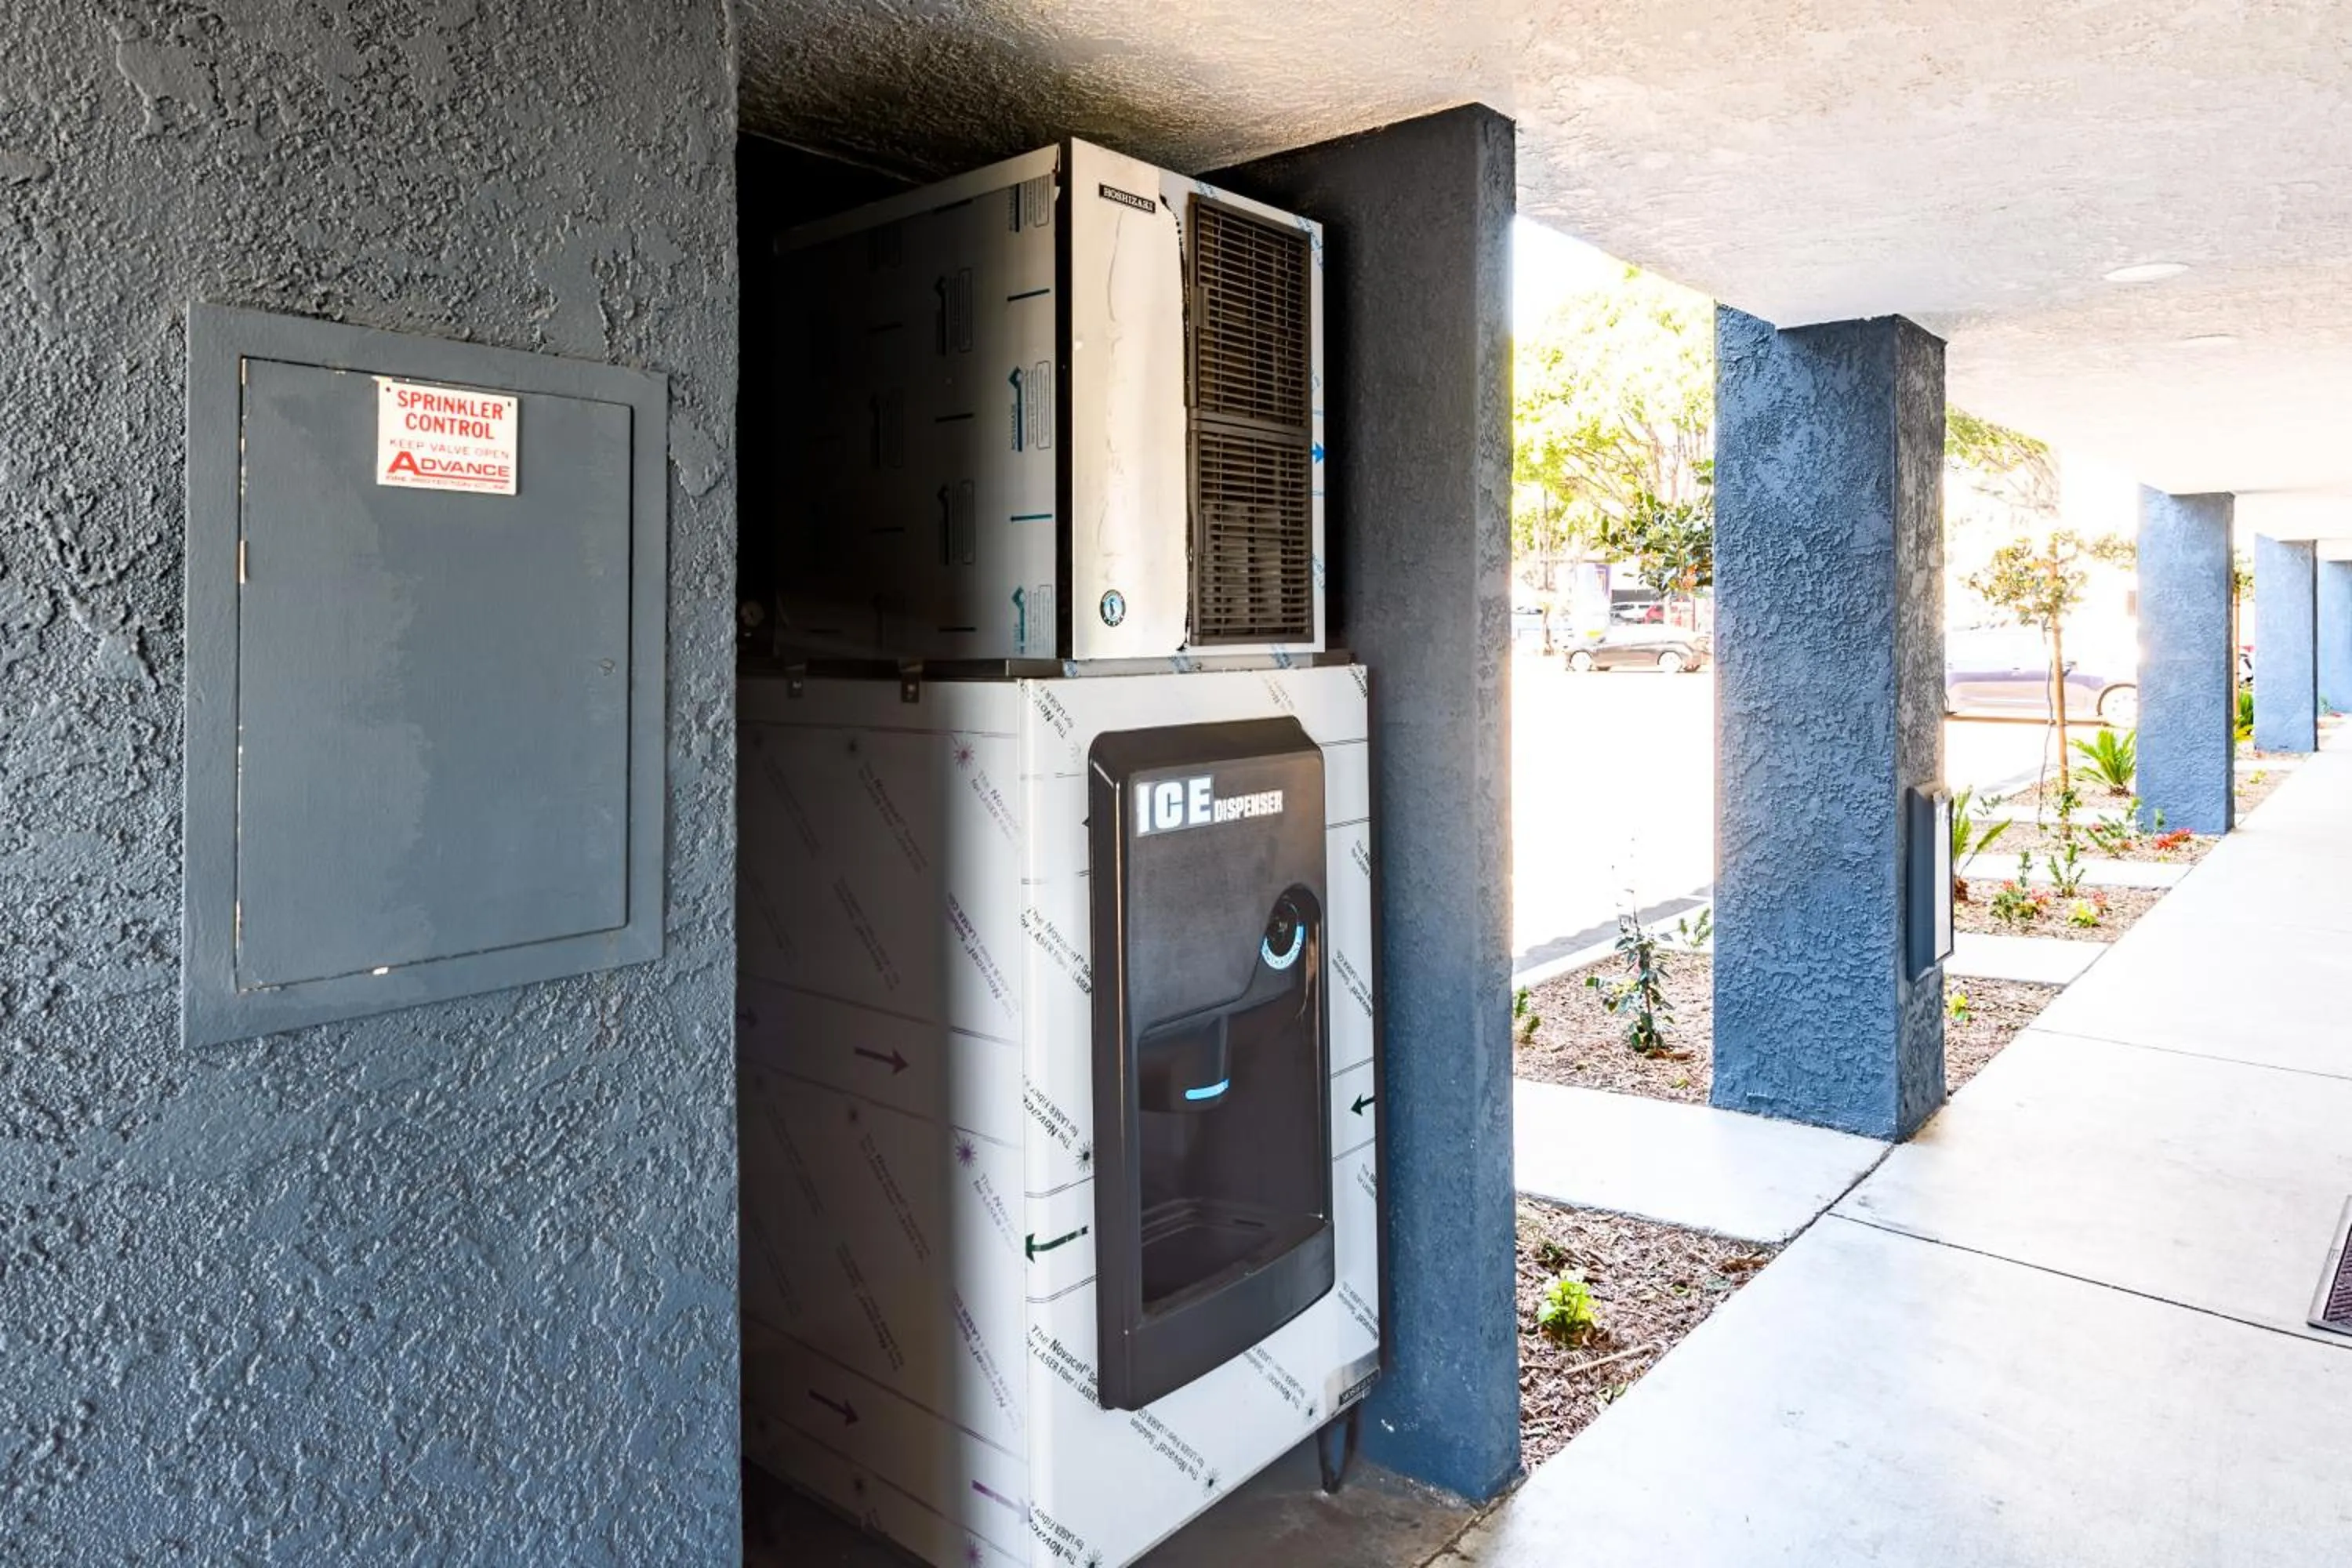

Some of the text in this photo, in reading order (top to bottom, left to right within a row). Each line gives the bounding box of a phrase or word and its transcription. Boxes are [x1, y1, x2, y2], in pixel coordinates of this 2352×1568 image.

[1103, 187, 1153, 211] HOSHIZAKI
[397, 390, 503, 420] SPRINKLER
[405, 412, 495, 440] CONTROL
[390, 439, 510, 459] KEEP VALVE OPEN
[387, 451, 510, 477] ADVANCE
[1136, 777, 1283, 835] ICE DISPENSER
